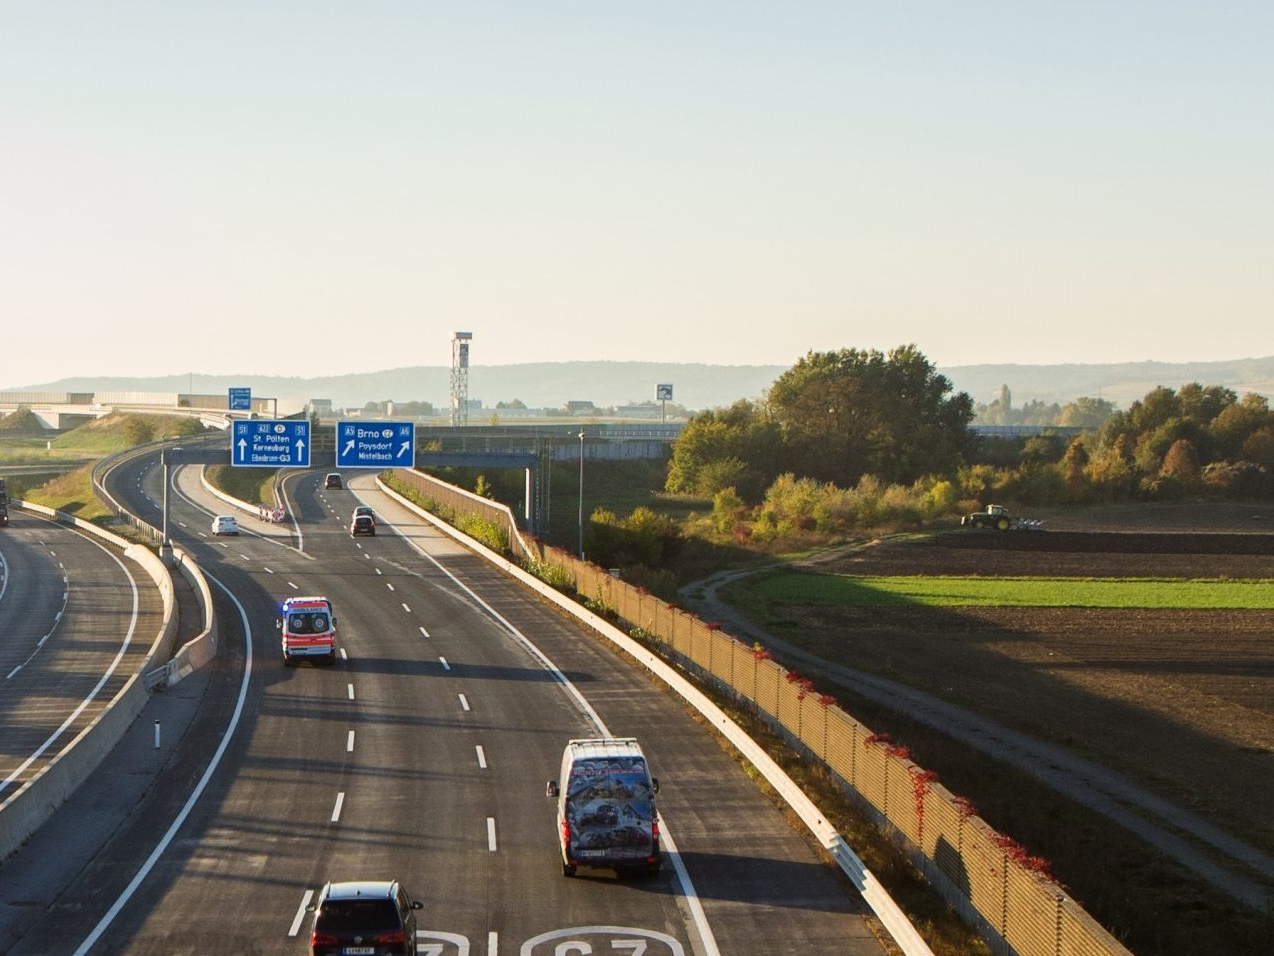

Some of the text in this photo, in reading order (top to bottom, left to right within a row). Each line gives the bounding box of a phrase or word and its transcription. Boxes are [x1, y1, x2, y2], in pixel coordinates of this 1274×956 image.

[357, 429, 380, 438] Brno
[253, 444, 290, 453] Korneuburg
[358, 442, 392, 451] Poysdorf
[358, 452, 393, 460] Mistelbach
